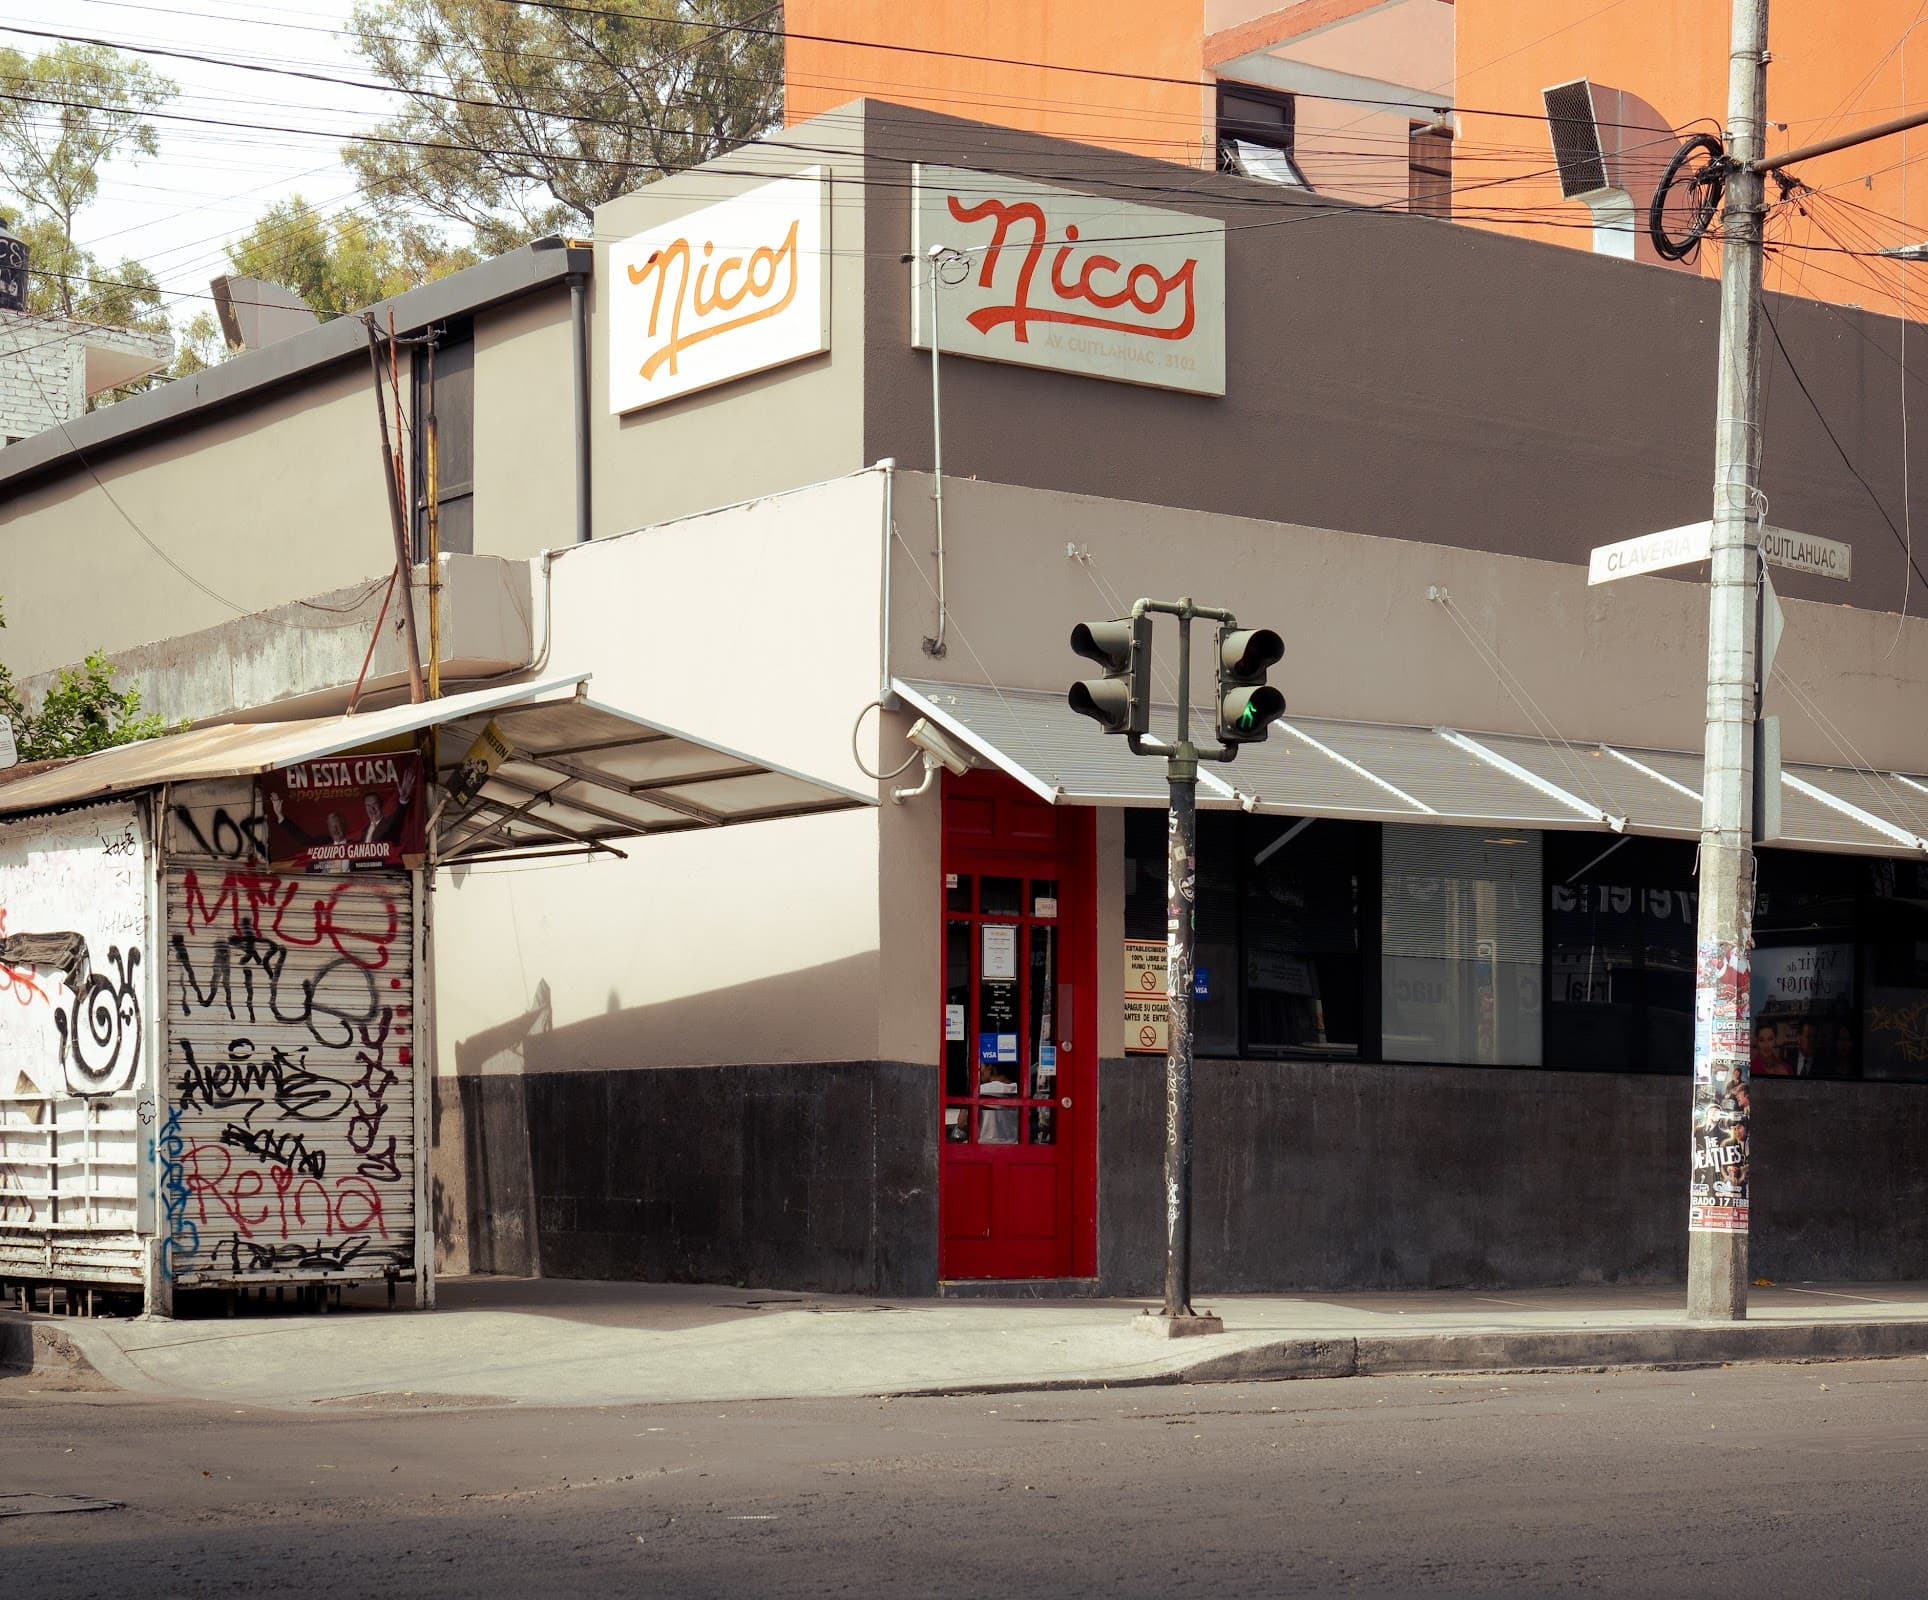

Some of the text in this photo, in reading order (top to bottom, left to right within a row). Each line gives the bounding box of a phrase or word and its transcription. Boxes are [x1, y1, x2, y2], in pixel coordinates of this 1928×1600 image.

[1067, 337, 1154, 365] CUITLAHUAC
[1764, 534, 1836, 569] CUITLAHUAC
[286, 759, 399, 789] EN ESTA CASA
[312, 845, 345, 859] EQUIPO
[347, 843, 390, 858] GANADOR
[1126, 945, 1168, 953] ESTABLECIMIENT
[1195, 986, 1208, 994] VISA
[1152, 1014, 1168, 1022] ENTRA
[982, 1051, 997, 1059] VISA
[1719, 1198, 1731, 1207] 17
